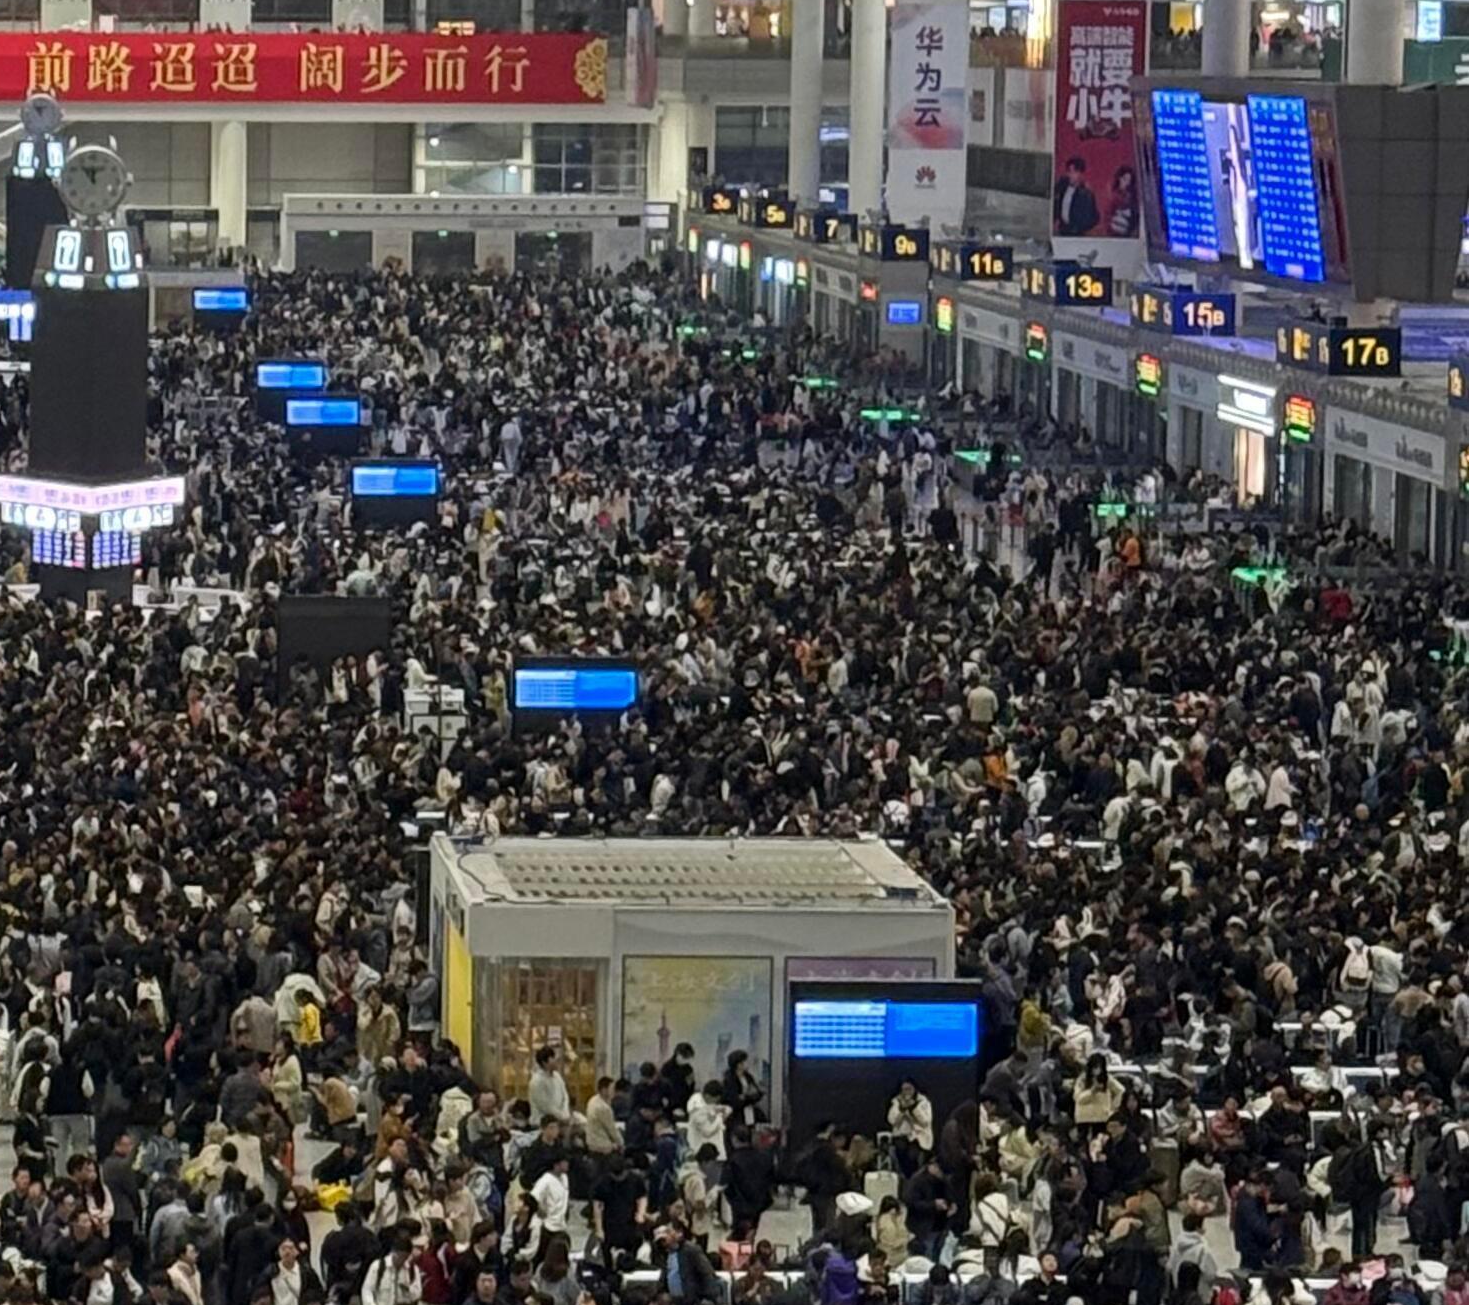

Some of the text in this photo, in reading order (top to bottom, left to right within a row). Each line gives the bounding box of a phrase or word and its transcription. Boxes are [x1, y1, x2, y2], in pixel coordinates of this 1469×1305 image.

[27, 41, 259, 93] 前路迢迢
[300, 42, 530, 93] 阔步而行
[914, 25, 943, 127] 华为云
[1069, 48, 1134, 88] 就要
[1067, 87, 1133, 130] 小牛
[970, 252, 1004, 274] 11B
[1065, 274, 1104, 298] 13B
[1183, 302, 1225, 326] 15B
[1341, 338, 1389, 365] 17B
